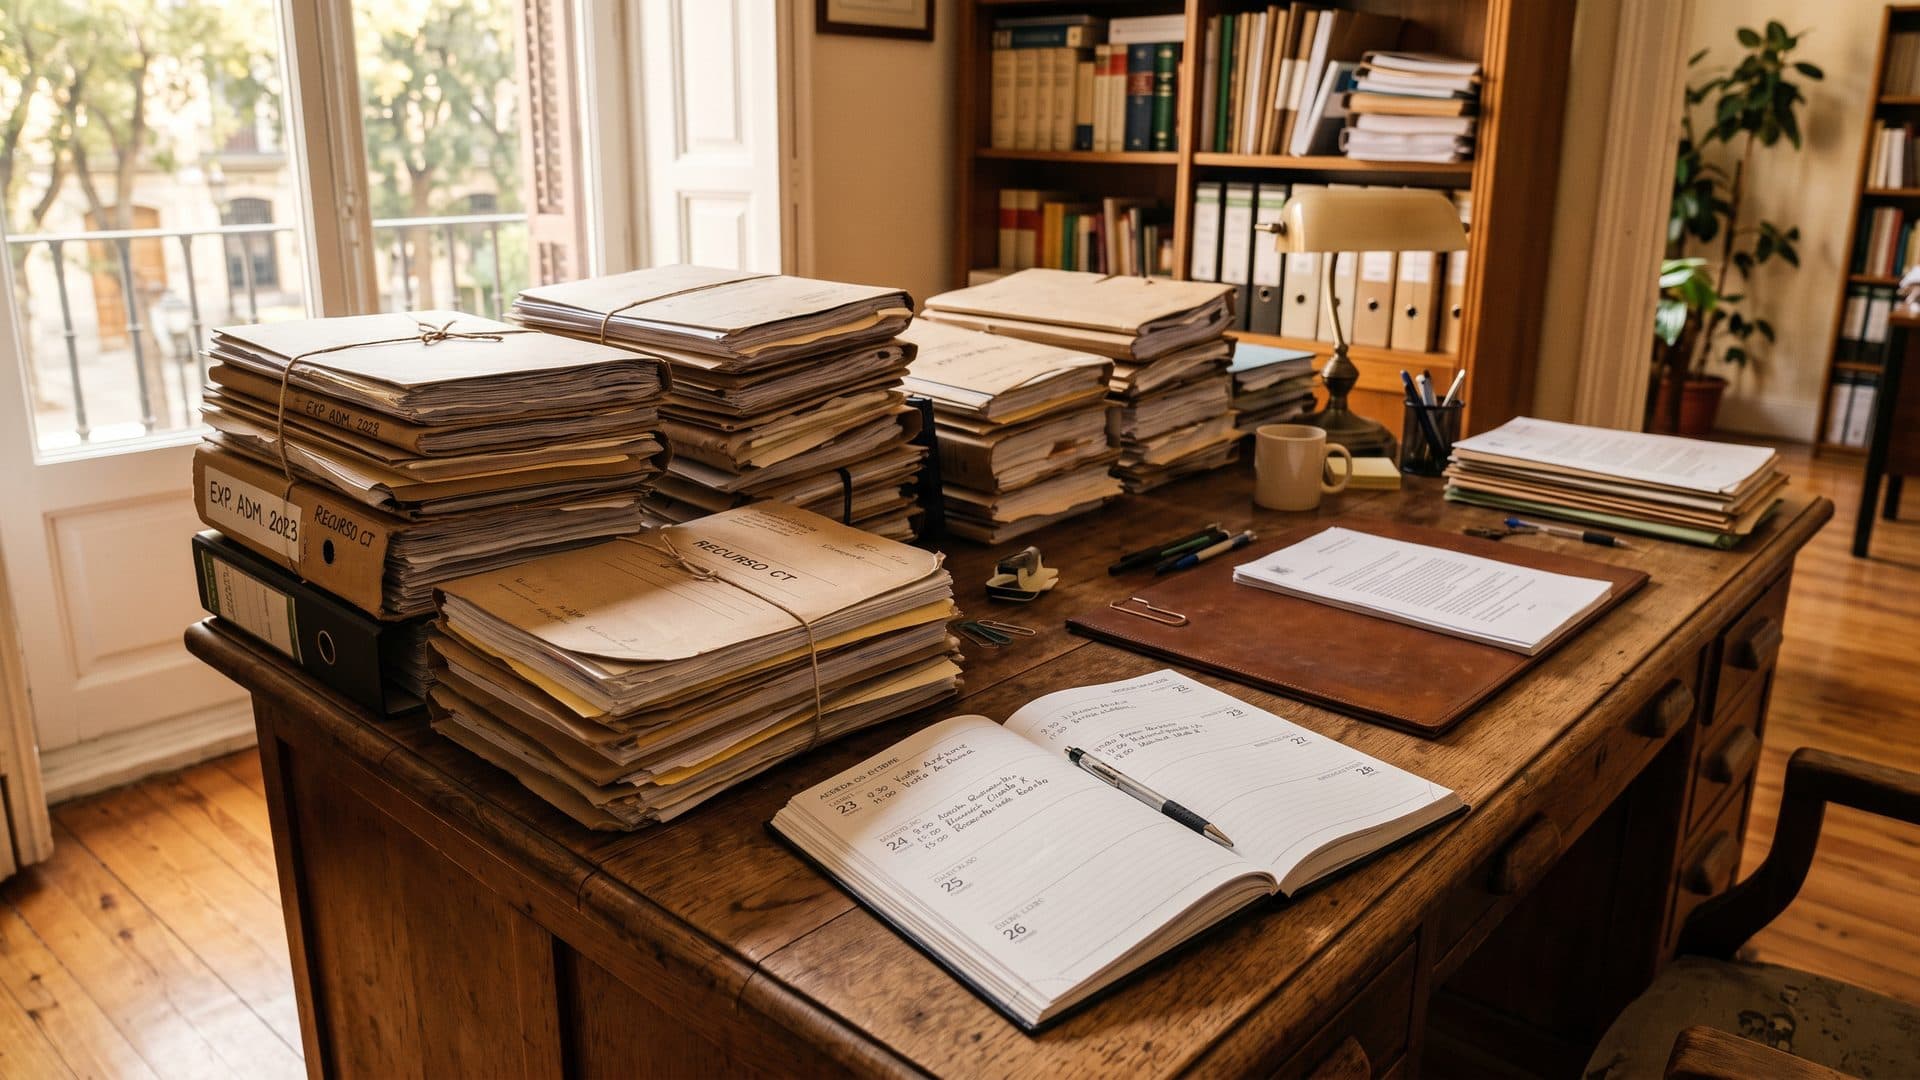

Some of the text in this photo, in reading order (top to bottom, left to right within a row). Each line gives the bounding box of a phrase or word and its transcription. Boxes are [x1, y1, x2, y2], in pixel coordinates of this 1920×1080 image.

[210, 481, 232, 511] EXP.
[237, 494, 264, 526] ADM.
[314, 505, 358, 541] RECURSO
[693, 540, 798, 581] RECURSO CT
[836, 800, 857, 814] 23
[886, 836, 908, 851] 24
[940, 876, 963, 892] 25
[1003, 923, 1026, 940] 26
